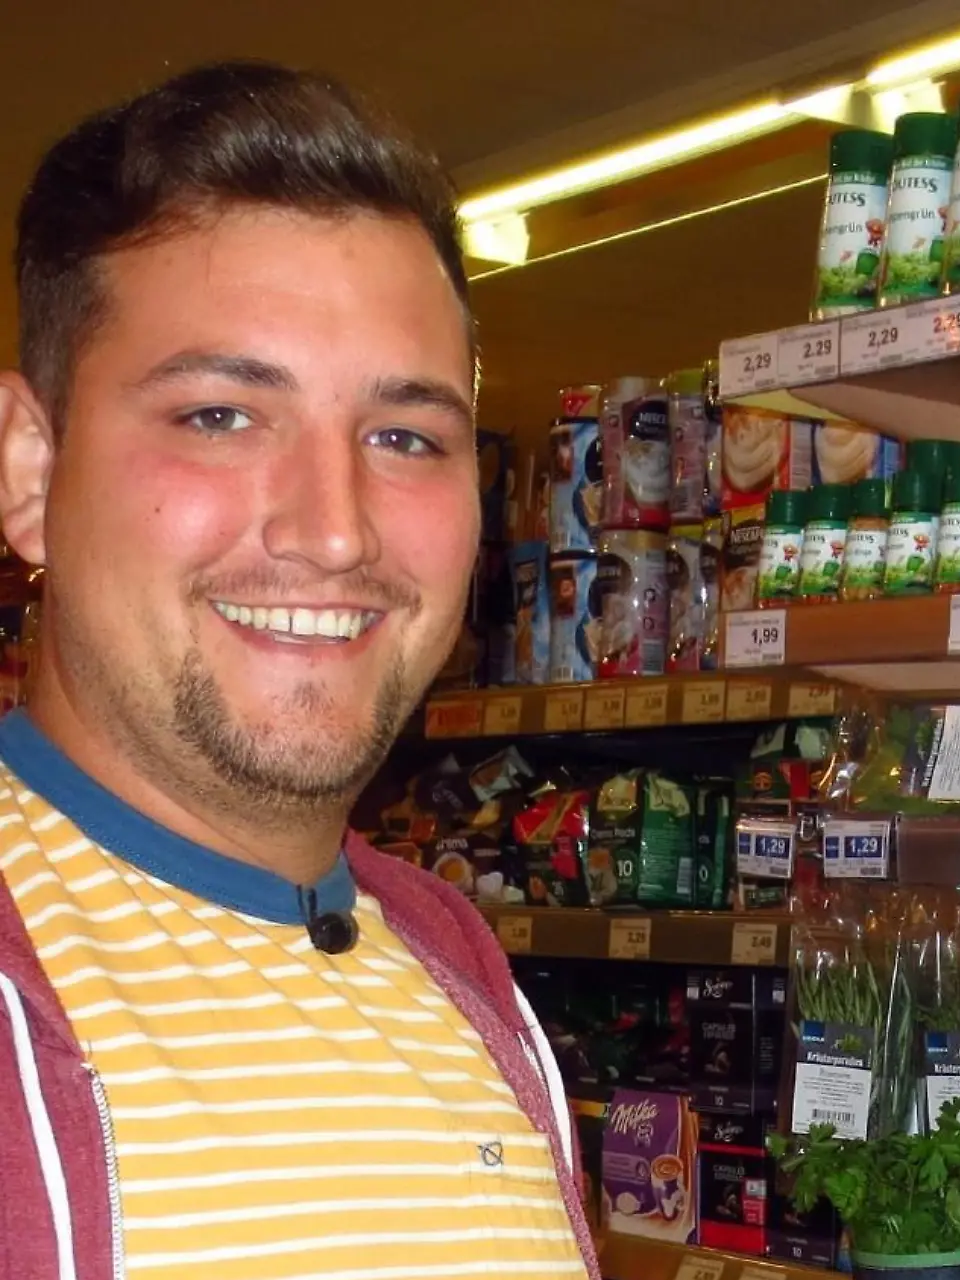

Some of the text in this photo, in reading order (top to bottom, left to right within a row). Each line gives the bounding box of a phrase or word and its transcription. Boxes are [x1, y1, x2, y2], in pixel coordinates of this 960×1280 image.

[868, 327, 898, 348] 2,29
[743, 353, 772, 373] 2,29
[751, 627, 779, 647] 1,99
[760, 838, 786, 854] 1,29
[849, 837, 878, 857] 1,29
[611, 1098, 661, 1135] Milka
